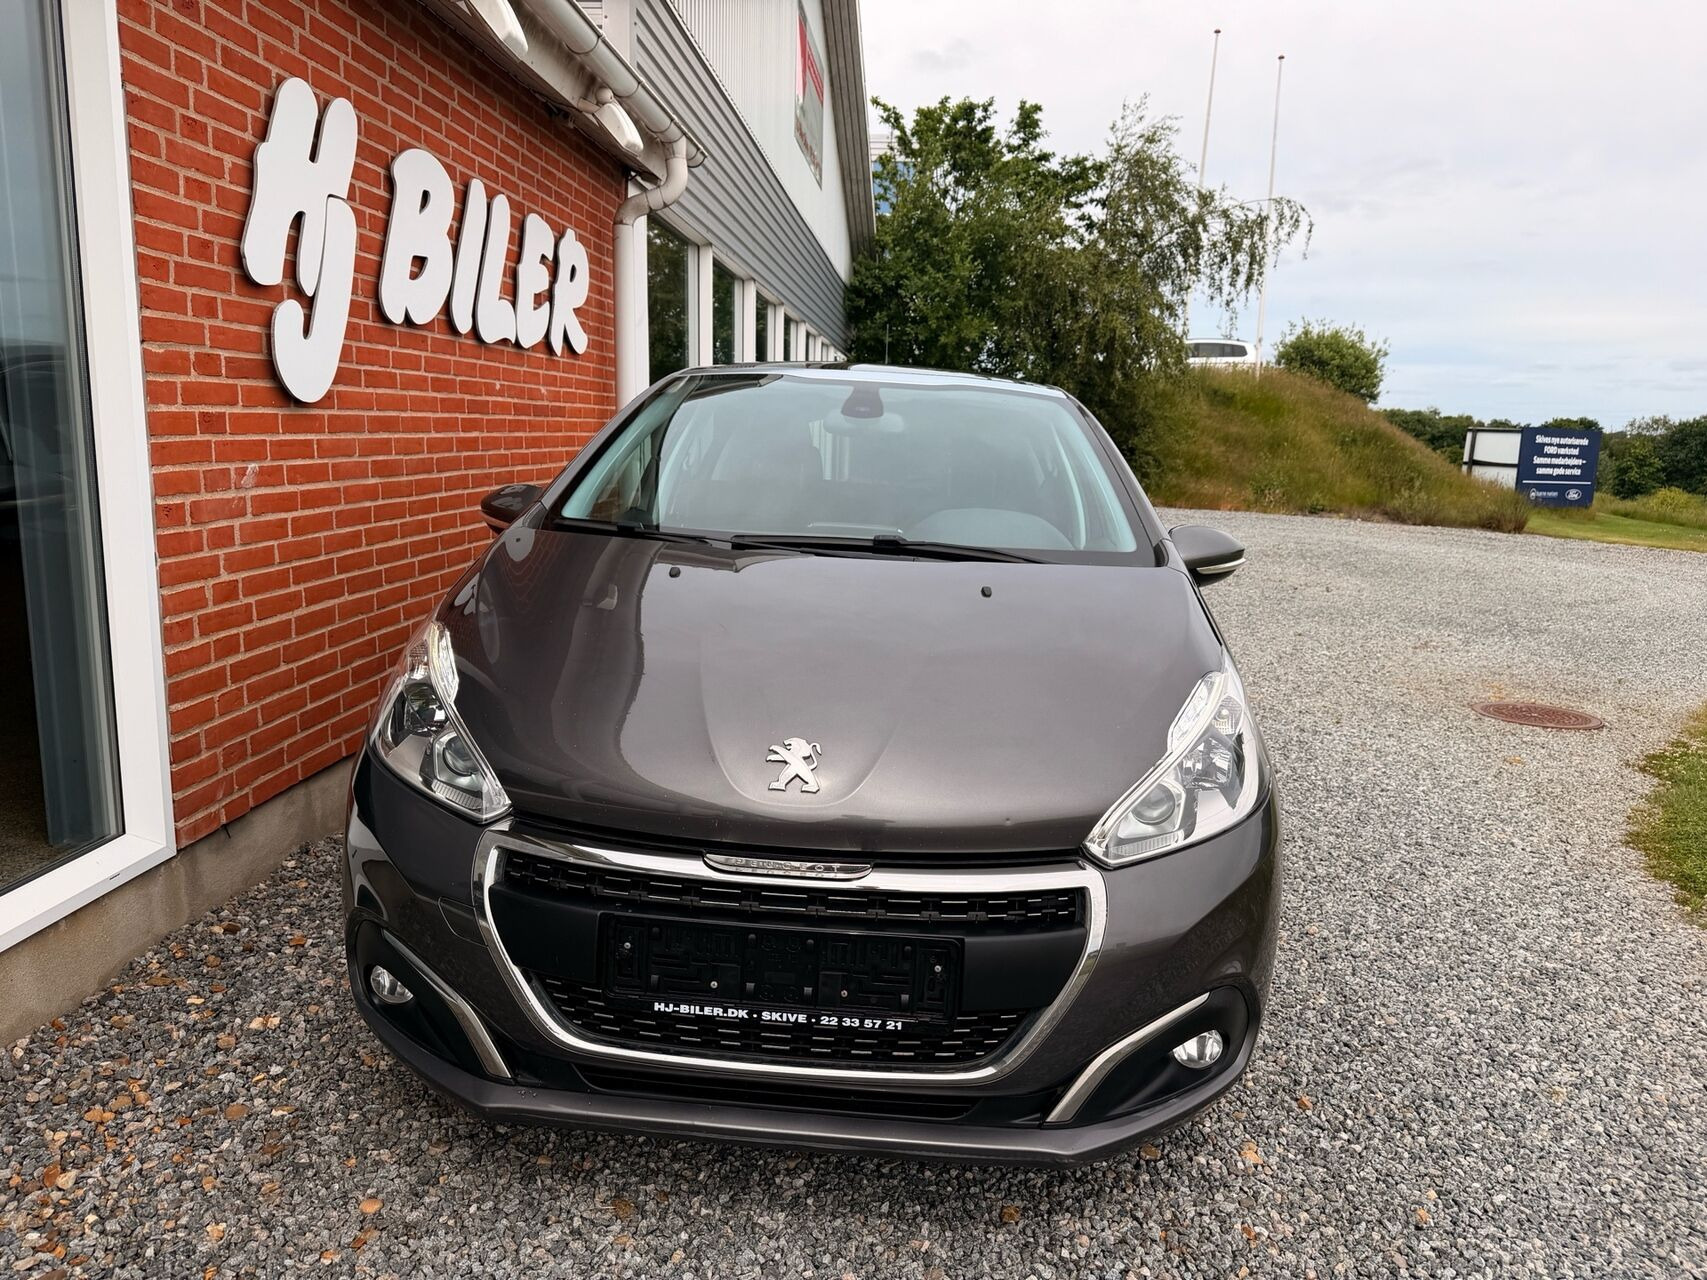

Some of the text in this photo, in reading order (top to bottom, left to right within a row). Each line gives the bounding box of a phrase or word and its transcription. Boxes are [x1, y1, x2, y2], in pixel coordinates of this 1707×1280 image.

[240, 77, 590, 403] HJ BILER
[1543, 445, 1557, 454] FORD
[1533, 455, 1551, 464] Samme
[1536, 467, 1553, 475] samme
[734, 858, 841, 873] PEUGEOT
[654, 1002, 749, 1018] HJ-BILER.DK
[761, 1011, 807, 1023] SKIVE
[820, 1016, 838, 1026] 22
[842, 1017, 860, 1027] 33
[863, 1019, 882, 1029] 57
[886, 1021, 902, 1030] 21
